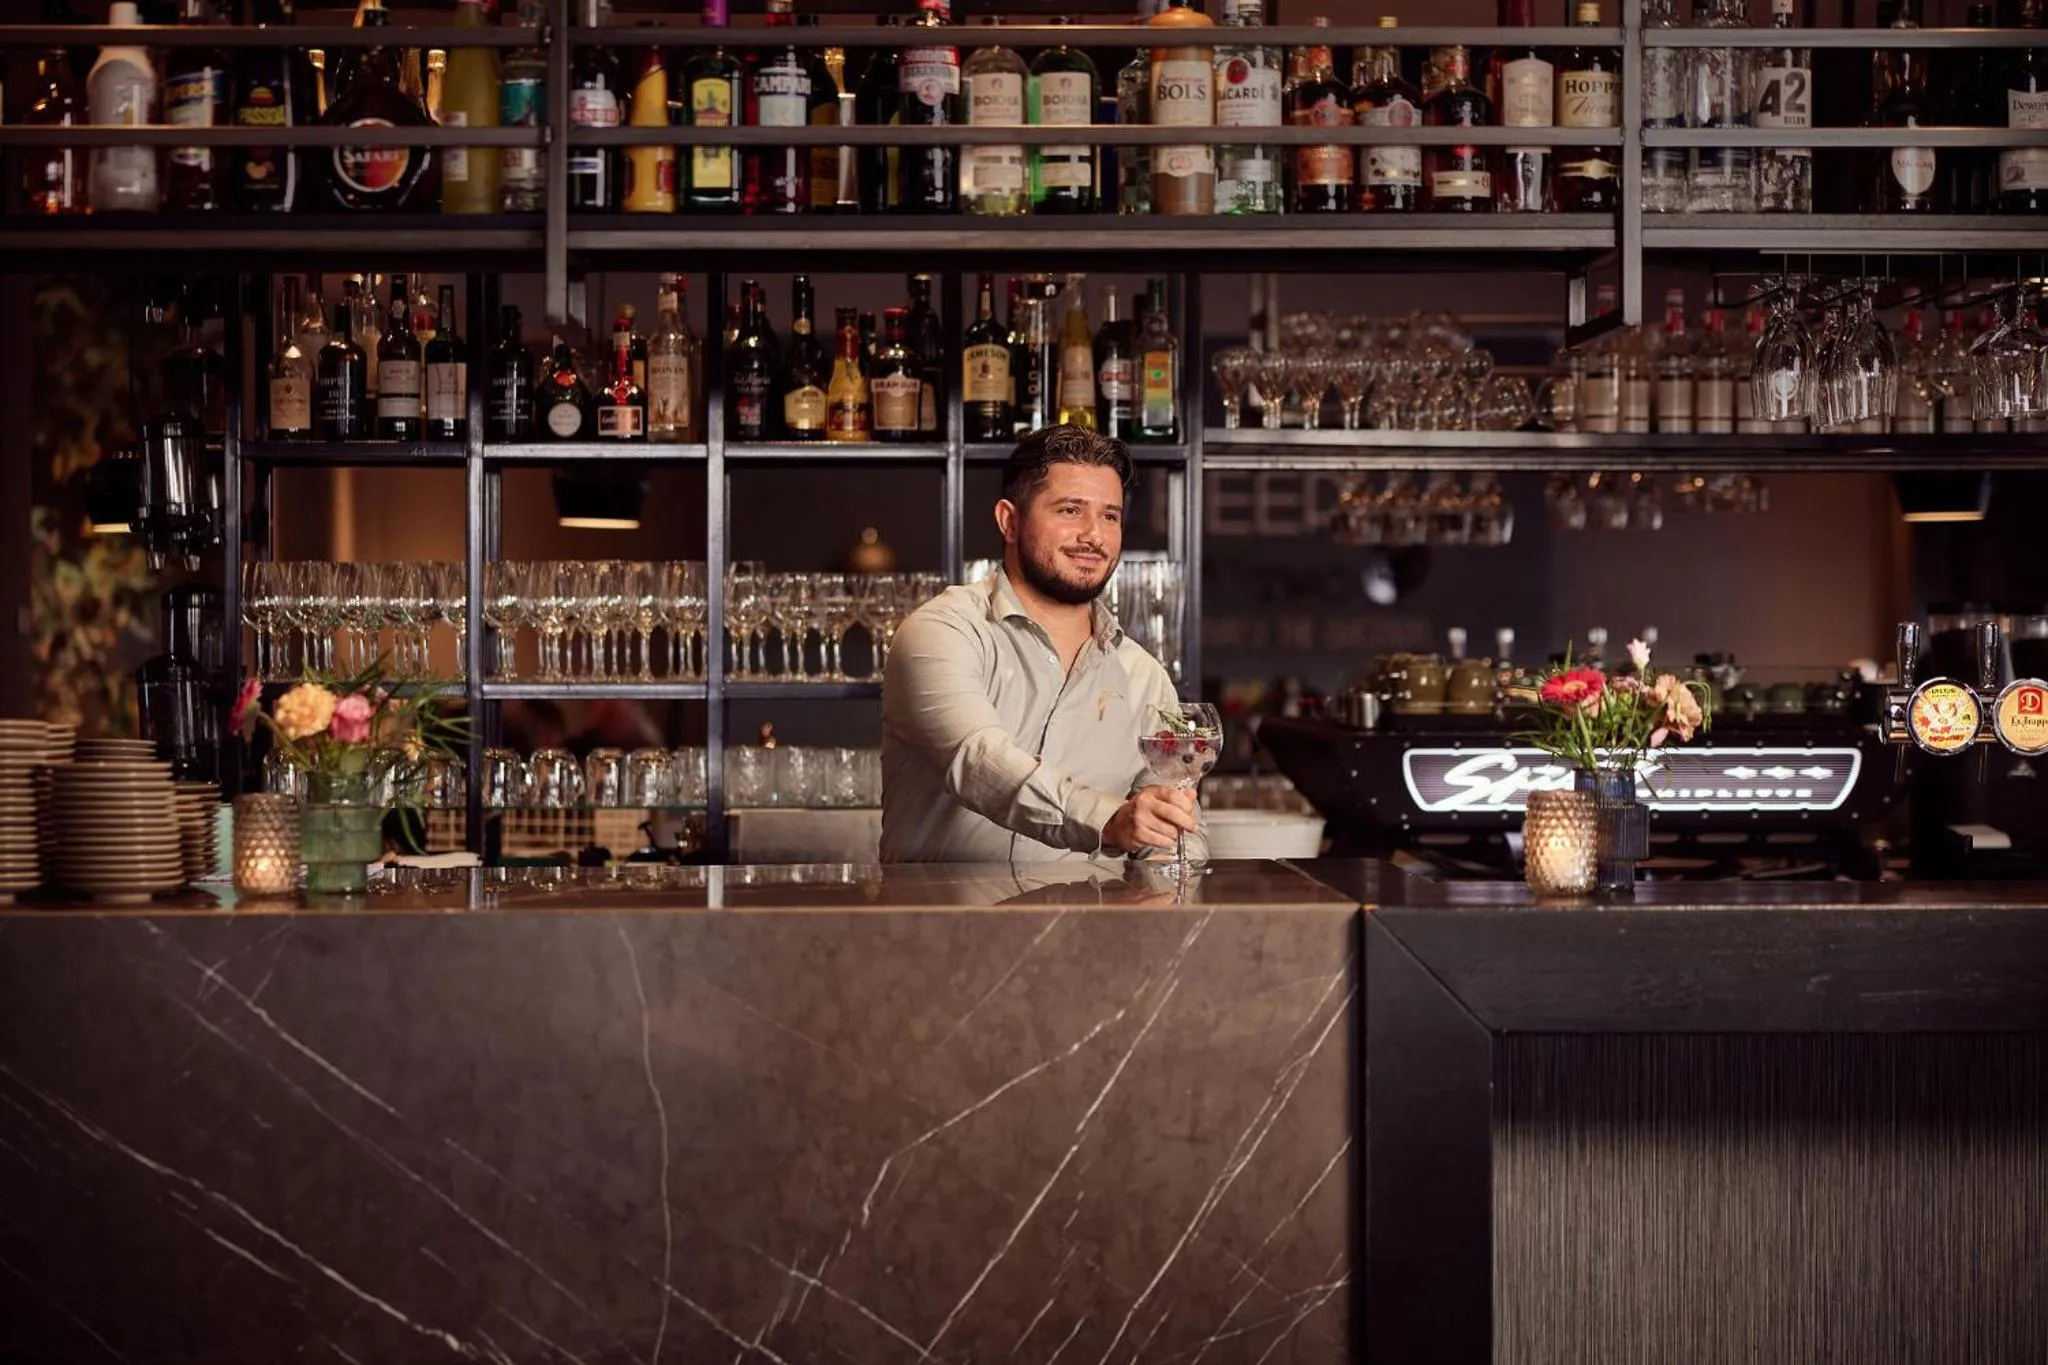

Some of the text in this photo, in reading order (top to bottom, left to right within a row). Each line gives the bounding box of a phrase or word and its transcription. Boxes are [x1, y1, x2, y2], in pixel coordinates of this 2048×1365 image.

[754, 76, 812, 94] CAMPARI
[1158, 84, 1206, 101] BOLS
[1759, 71, 1806, 117] 42
